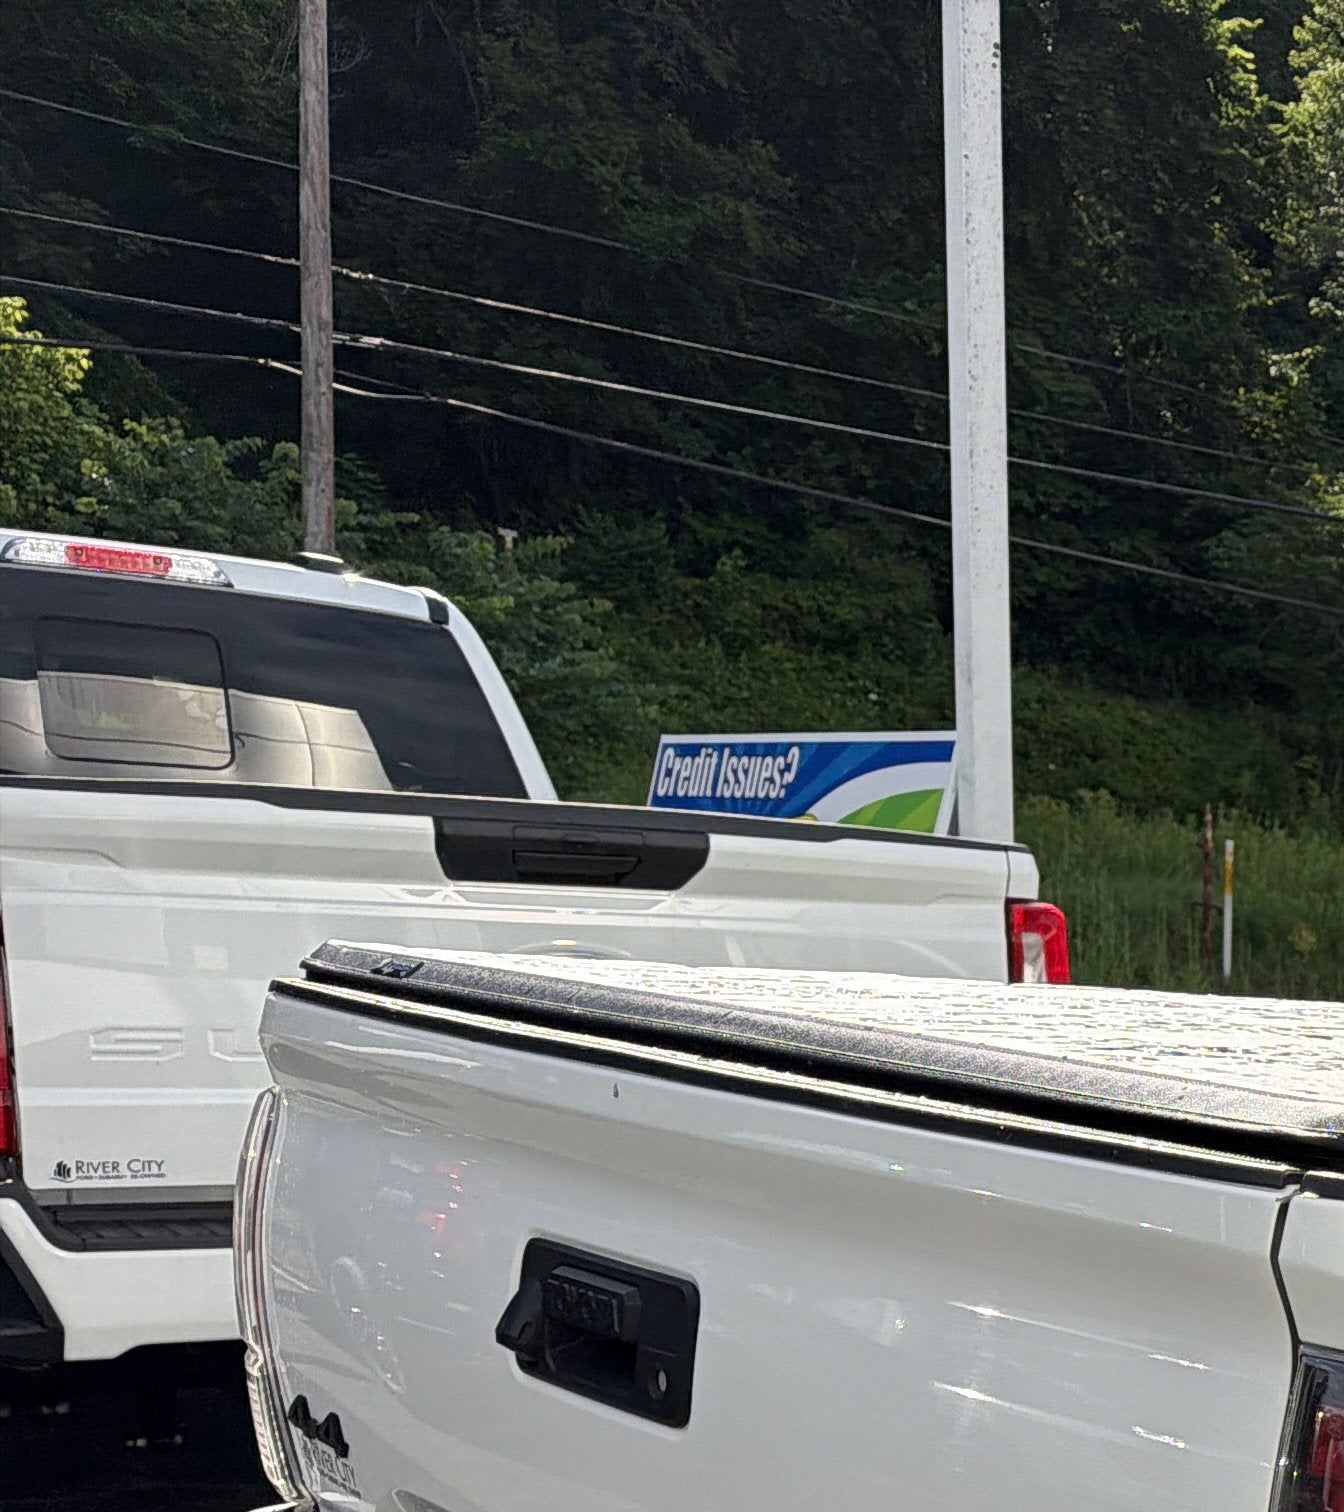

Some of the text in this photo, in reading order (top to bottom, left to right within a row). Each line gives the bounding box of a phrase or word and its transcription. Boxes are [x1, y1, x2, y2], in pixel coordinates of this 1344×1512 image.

[657, 746, 800, 799] Credit Issues?
[76, 1159, 165, 1174] RIVER CITY
